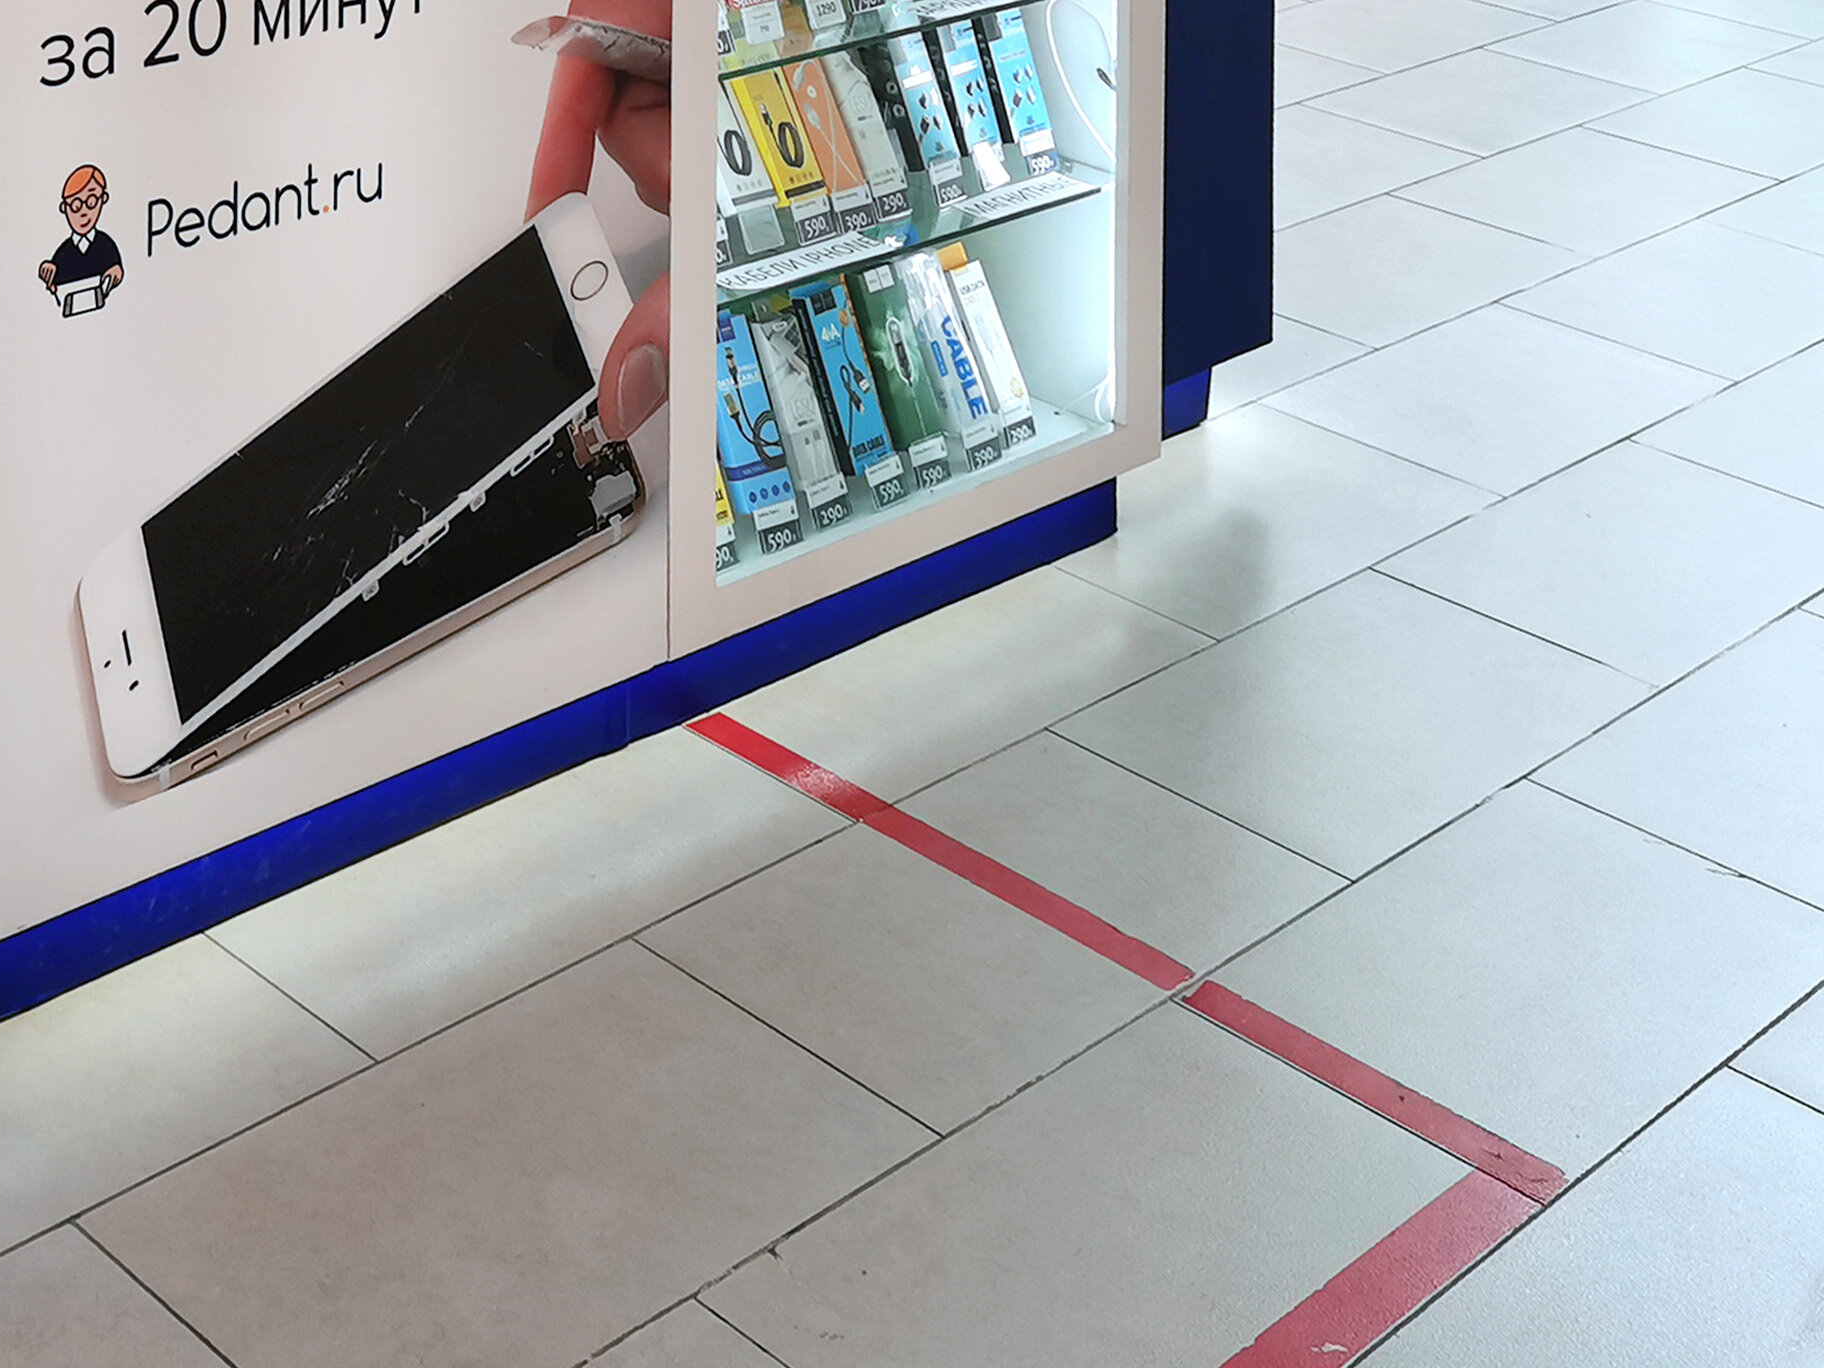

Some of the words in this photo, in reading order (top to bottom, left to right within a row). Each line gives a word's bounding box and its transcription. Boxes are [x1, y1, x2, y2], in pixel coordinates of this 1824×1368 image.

[41, 24, 116, 87] за
[148, 161, 384, 257] Pedant.ru
[963, 176, 1079, 216] МАГНИТНЫЕ
[719, 256, 798, 289] КАБЕЛИ
[801, 236, 880, 269] IPHONE
[941, 315, 988, 420] CABLE
[716, 547, 732, 565] 90
